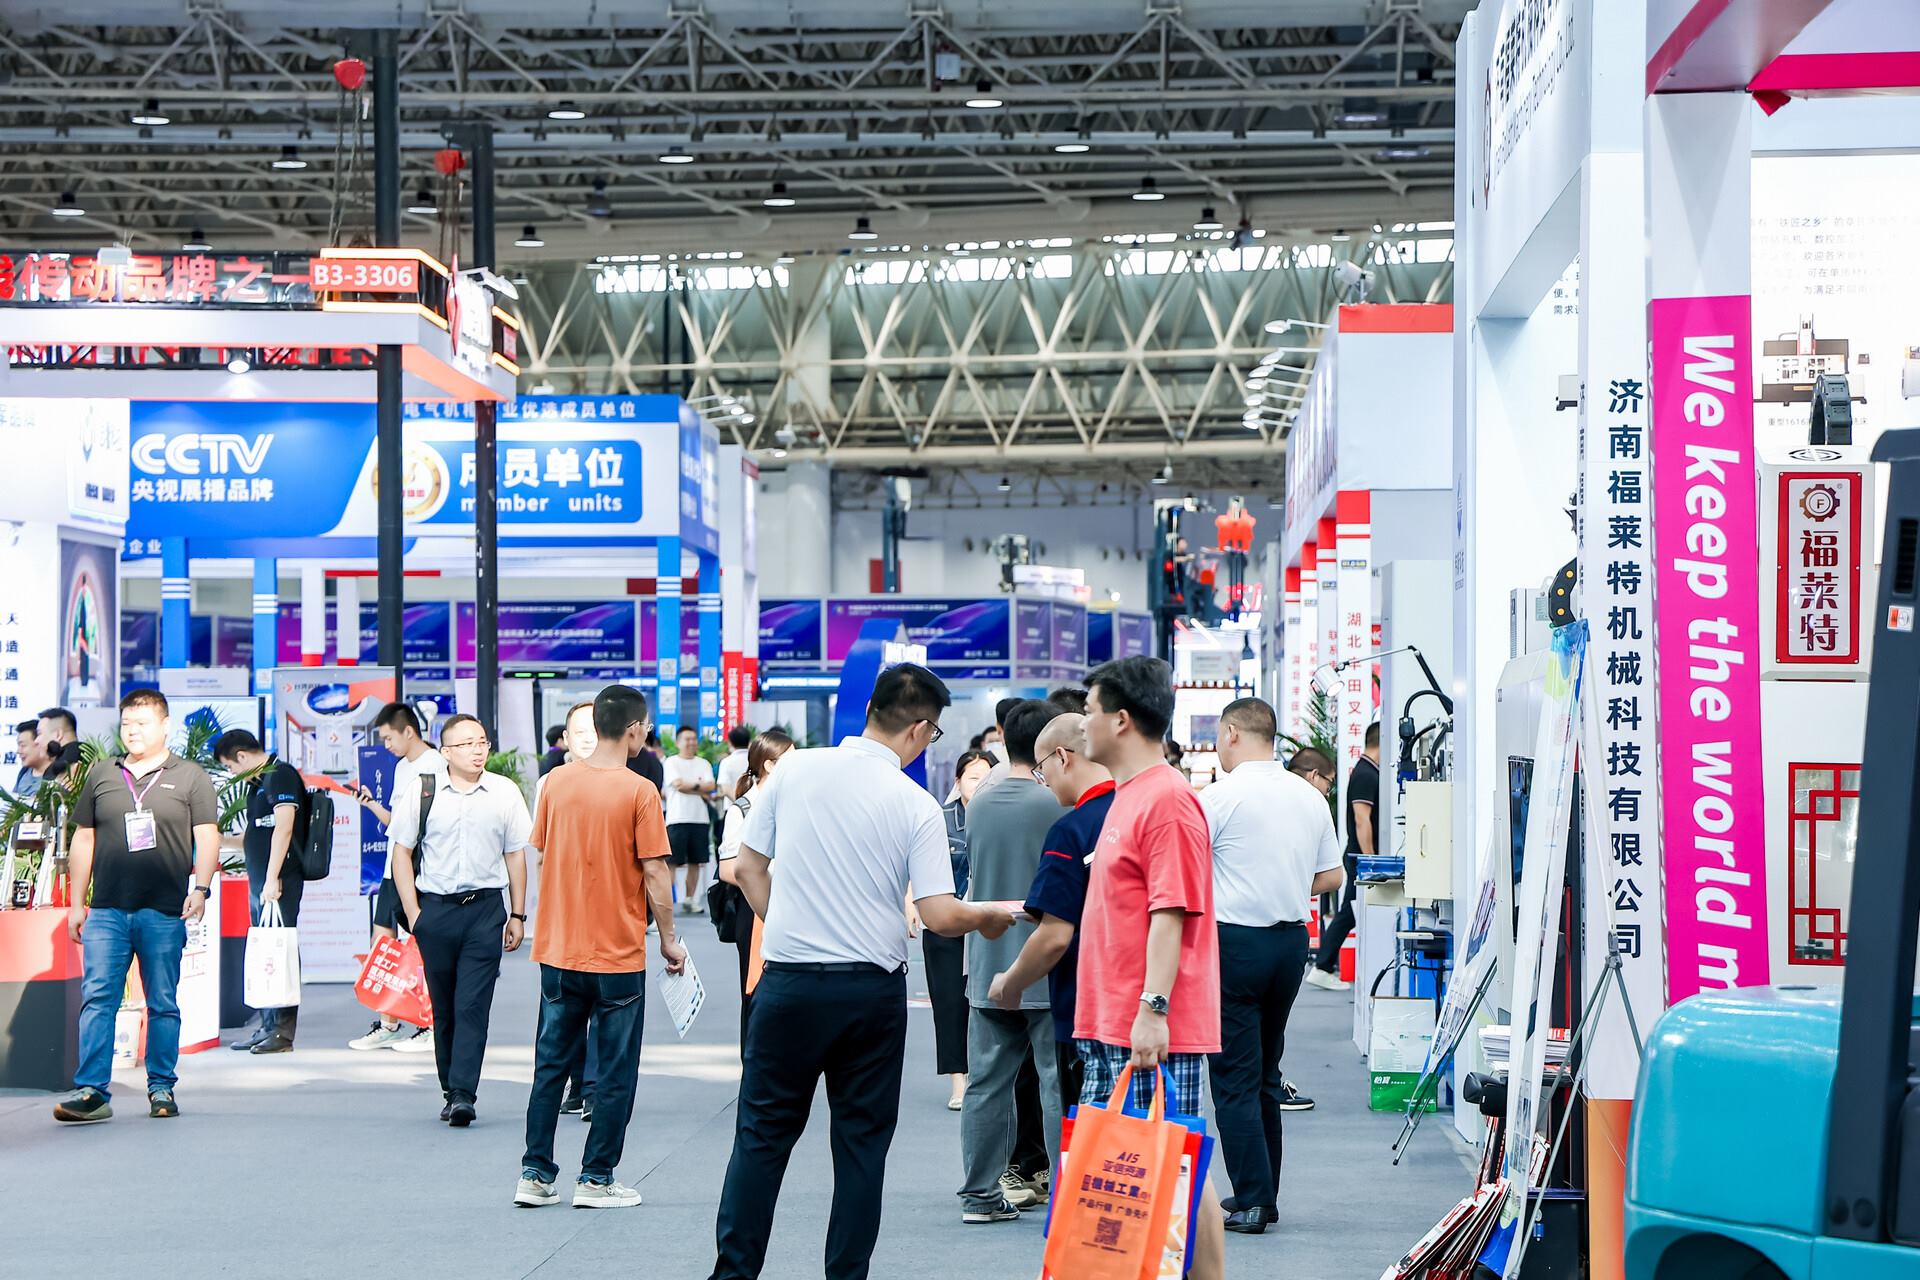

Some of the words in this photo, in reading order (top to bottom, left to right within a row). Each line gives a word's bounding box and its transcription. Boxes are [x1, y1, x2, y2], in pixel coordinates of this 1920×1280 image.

[314, 264, 413, 288] B3-3306
[404, 401, 637, 418] 电气机柜业优选成员单位
[1682, 334, 1736, 428] We
[131, 433, 275, 475] CCTV
[132, 477, 275, 503] 央视展播品牌
[460, 493, 549, 513] mmber
[568, 491, 623, 513] units
[1673, 443, 1741, 600] keep
[1799, 529, 1840, 652] 福莱特
[1347, 612, 1362, 780] 湖北丰田叉车有
[1606, 378, 1644, 960] 济南福莱特机械科技有限公司
[1687, 616, 1746, 723] the
[1691, 740, 1753, 930] world
